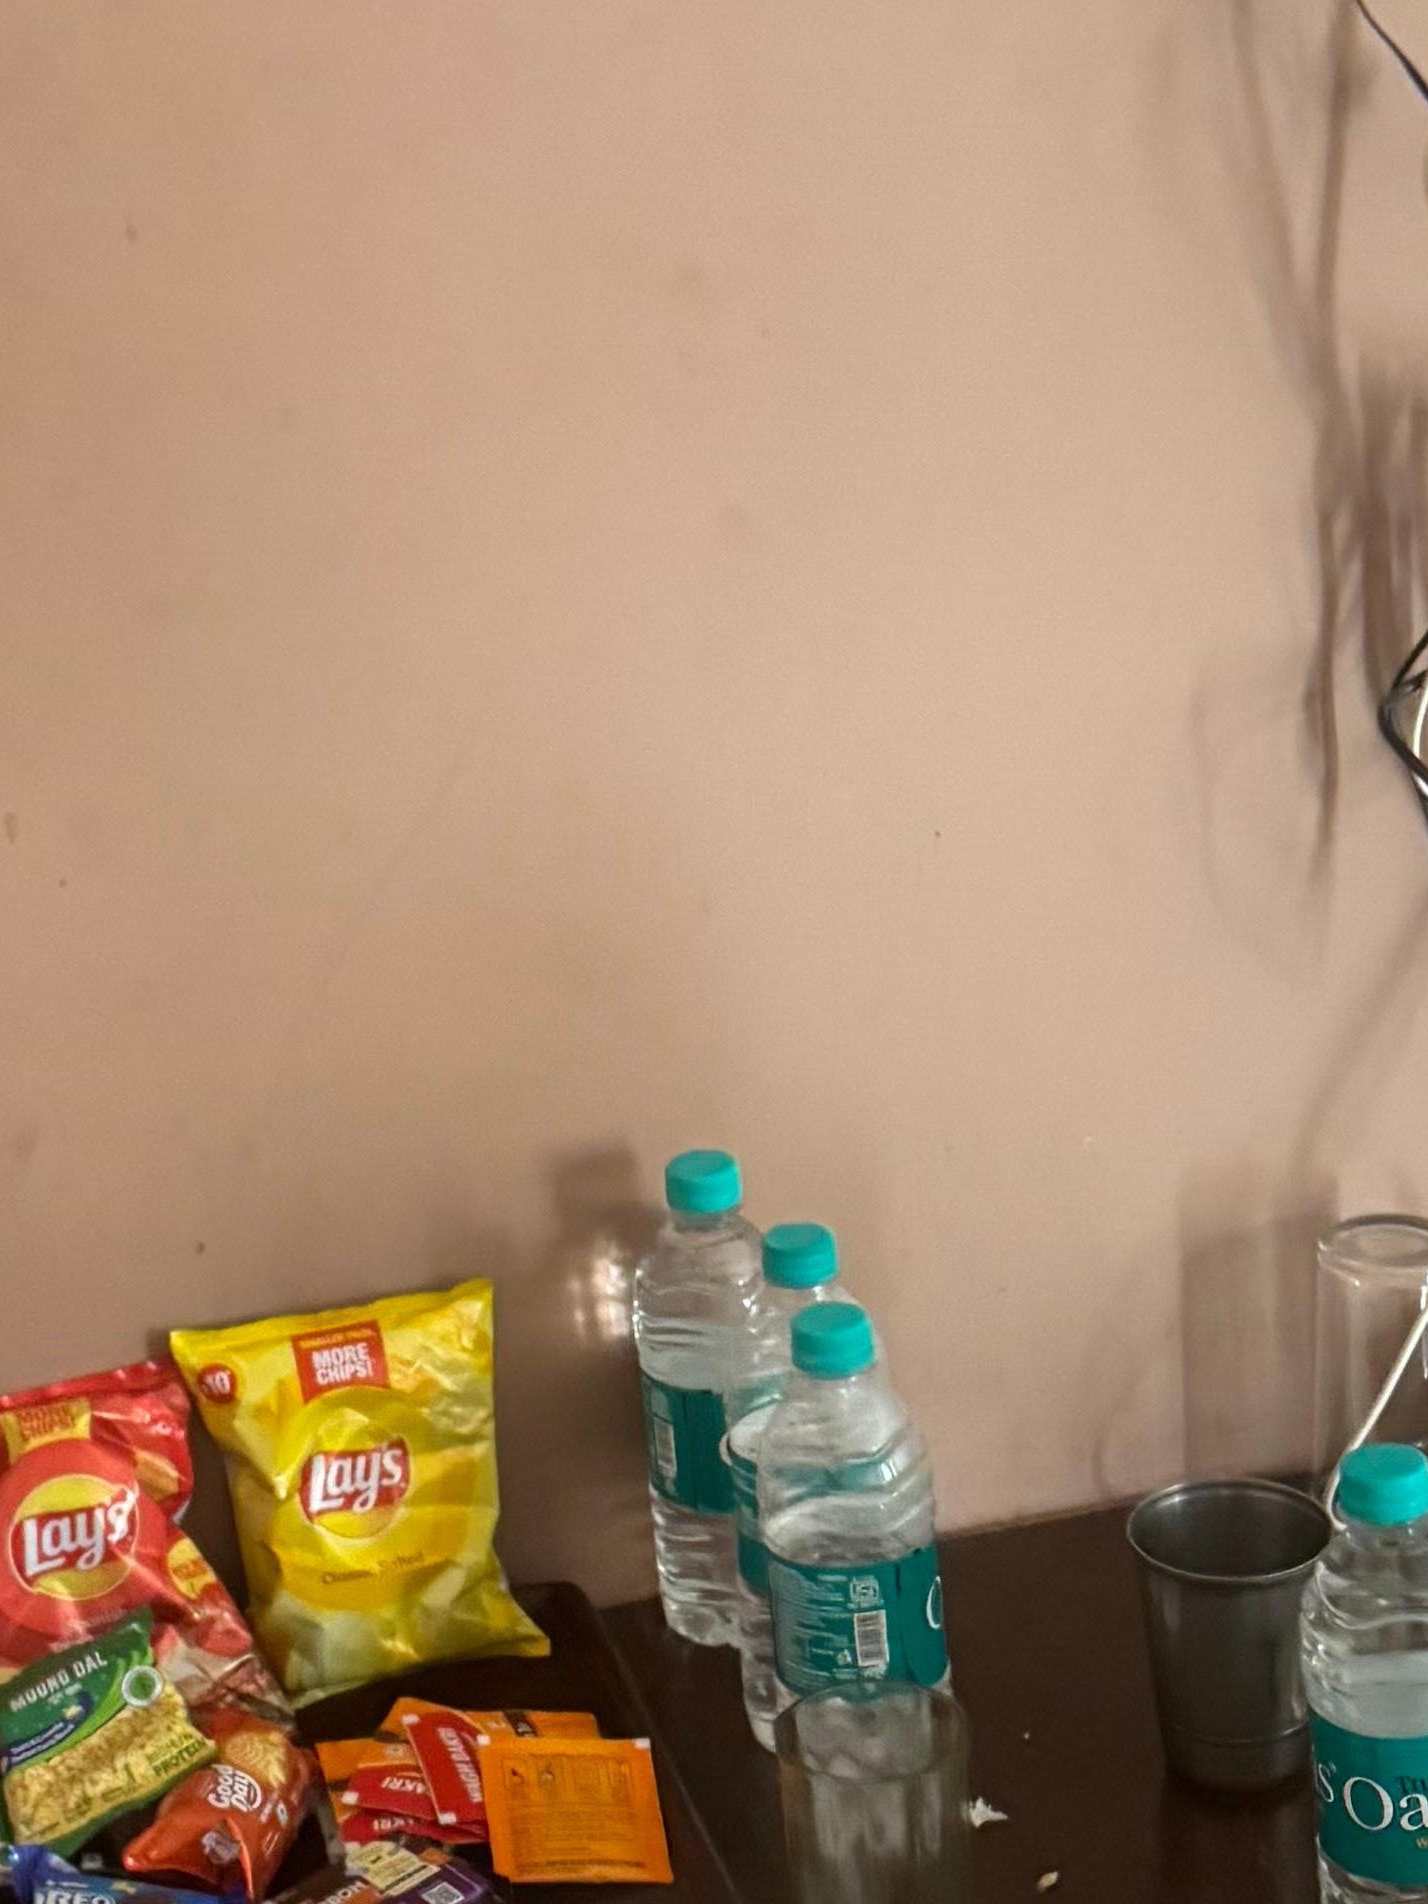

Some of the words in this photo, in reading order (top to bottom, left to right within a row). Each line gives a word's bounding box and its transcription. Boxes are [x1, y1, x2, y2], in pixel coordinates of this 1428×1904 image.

[312, 1342, 370, 1369] MORE
[309, 1442, 404, 1514] Lay's
[23, 1486, 139, 1577] Lay's
[206, 1763, 235, 1809] Good
